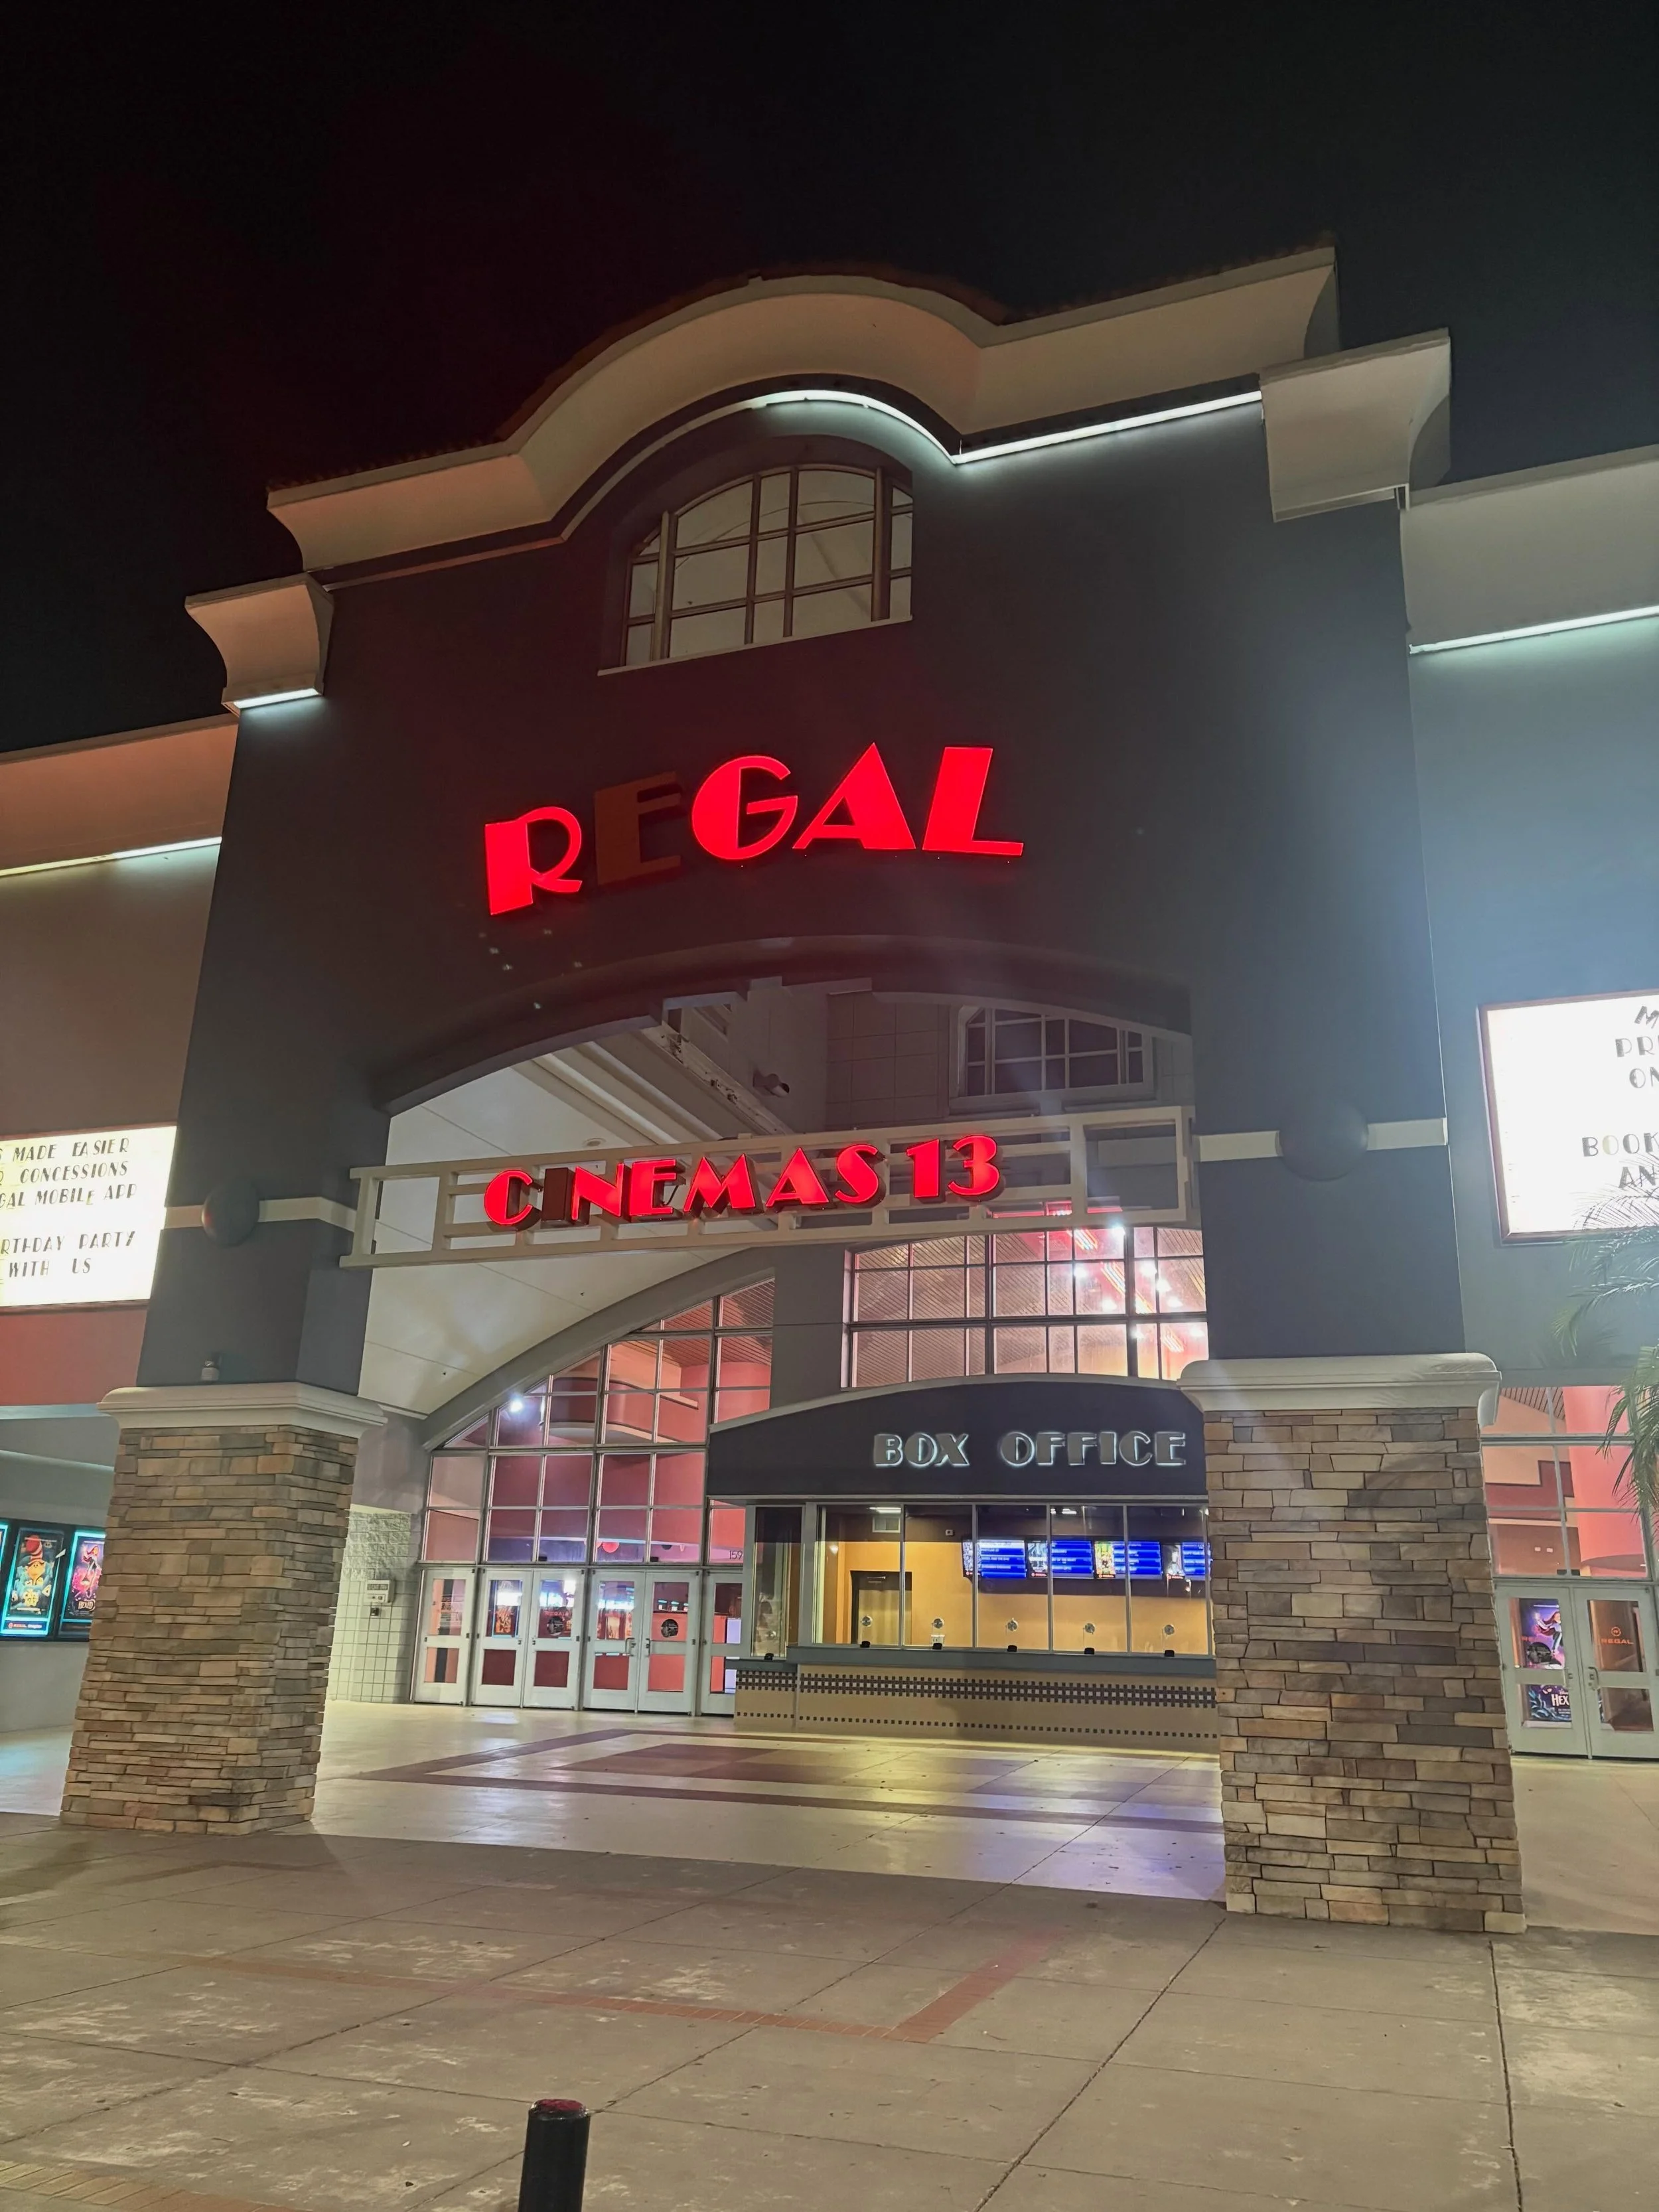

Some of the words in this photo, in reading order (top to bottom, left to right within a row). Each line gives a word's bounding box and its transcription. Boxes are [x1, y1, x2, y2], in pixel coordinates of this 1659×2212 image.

[484, 742, 1024, 916] REGAL
[1615, 1035, 1659, 1057] PR
[13, 1144, 57, 1162] MADE
[72, 1138, 129, 1157] EASIER
[20, 1161, 129, 1184] CONCESSIONS
[484, 1143, 883, 1227] CINEMAS
[906, 1134, 1002, 1203] 13
[35, 1187, 94, 1205] MOBILE
[104, 1183, 137, 1200] APP
[0, 1236, 65, 1254] RTHDAY
[78, 1230, 135, 1249] PARTY
[9, 1260, 50, 1278] WITH
[72, 1258, 92, 1274] US
[873, 1432, 970, 1467] BOX
[1000, 1430, 1187, 1467] OFFICE
